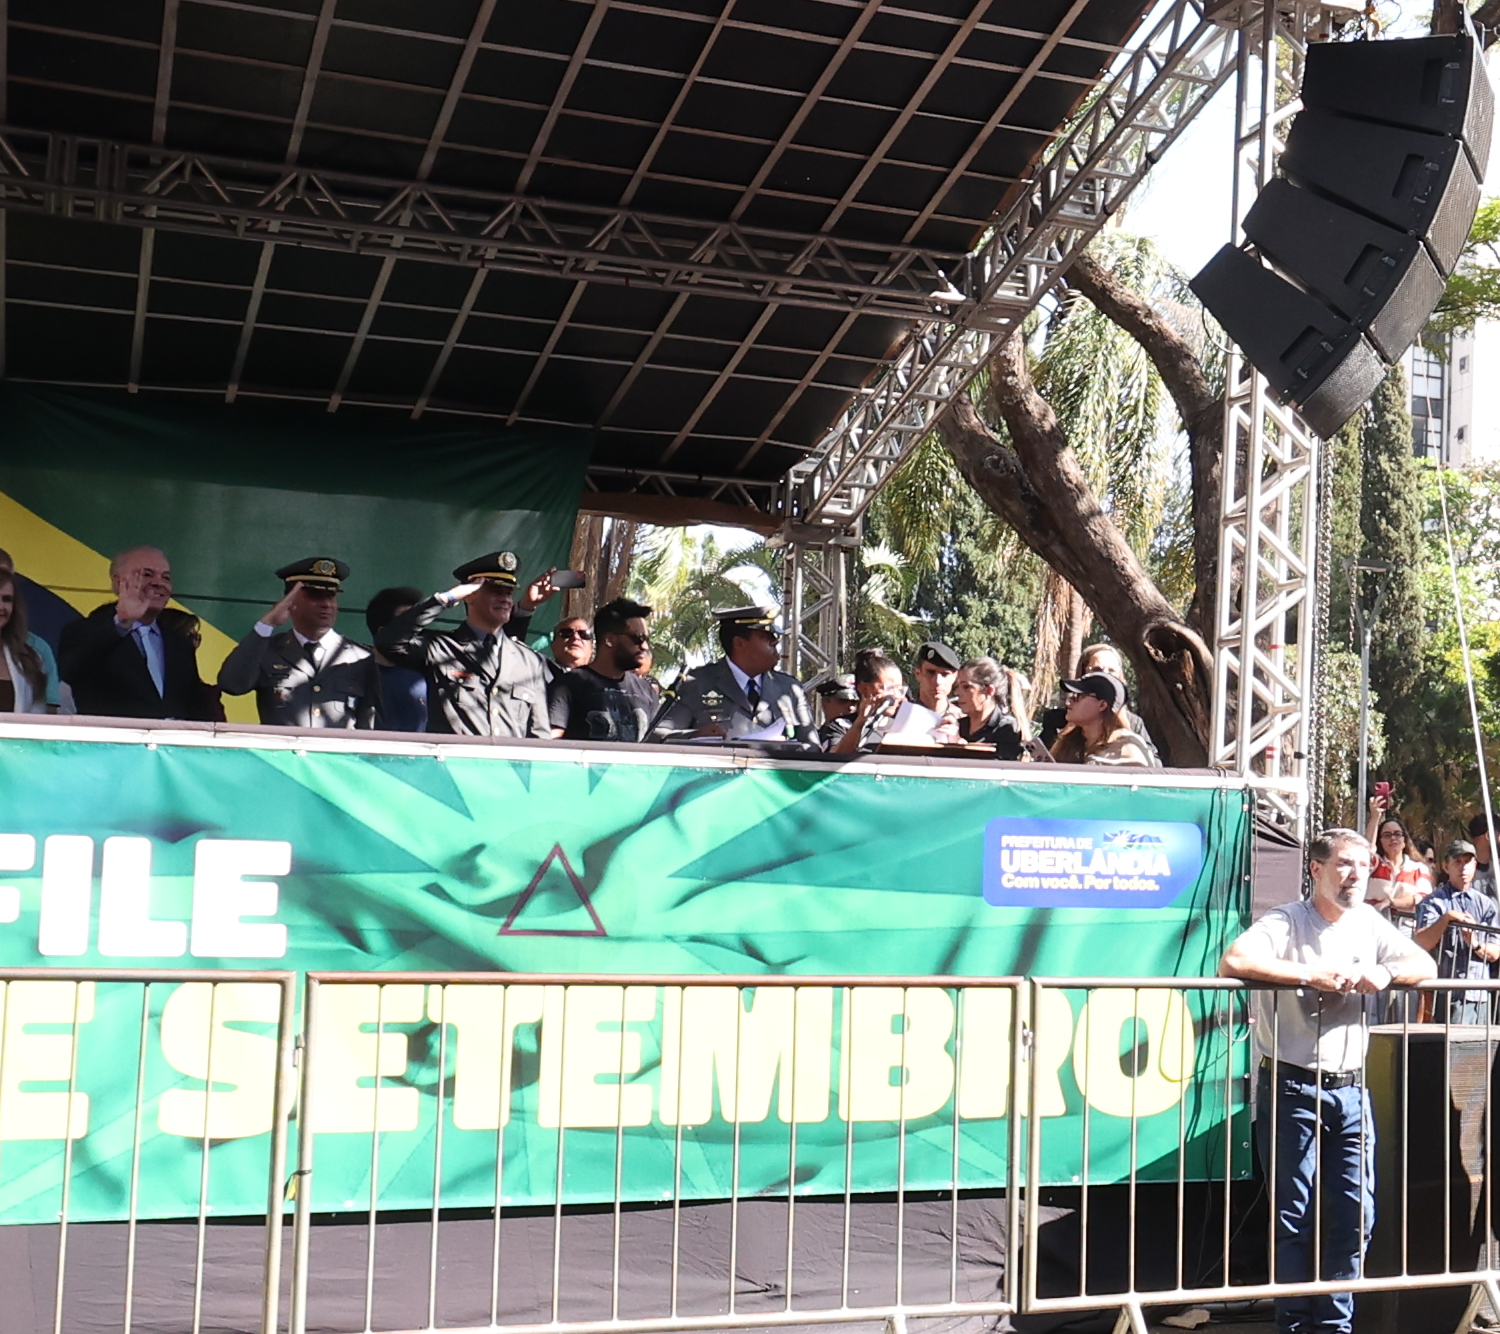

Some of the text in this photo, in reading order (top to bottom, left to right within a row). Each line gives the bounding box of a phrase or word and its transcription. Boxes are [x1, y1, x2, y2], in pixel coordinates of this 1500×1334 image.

[1001, 835, 1094, 850] PREFEITURA DE
[1000, 847, 1171, 876] UBERLÂNDIA
[1001, 873, 1160, 891] Com você. Por todos.
[157, 979, 1196, 1144] SETEMBRO
